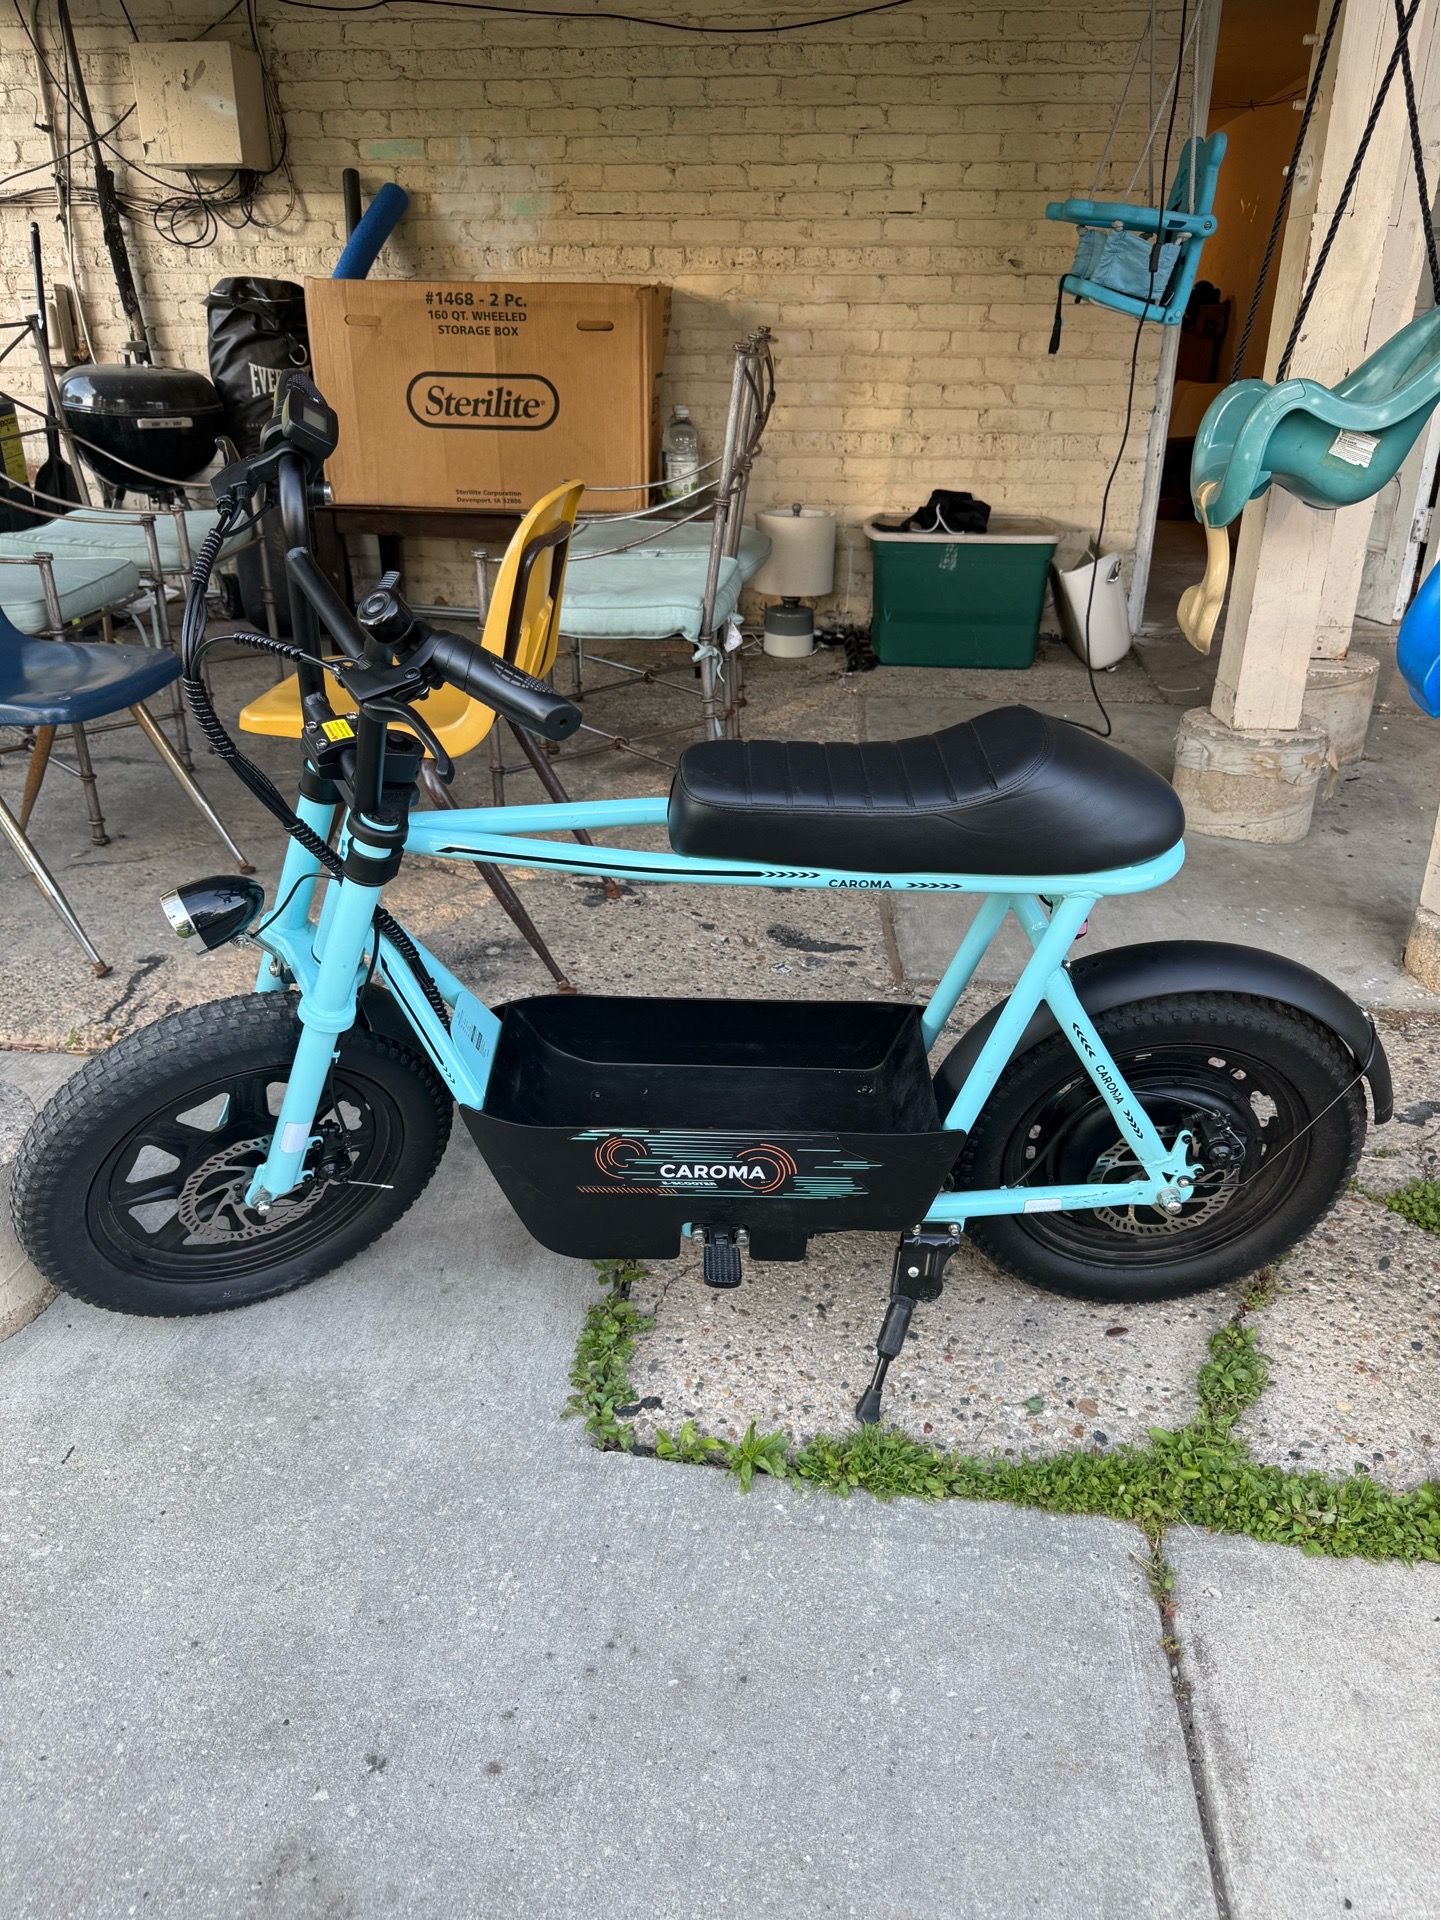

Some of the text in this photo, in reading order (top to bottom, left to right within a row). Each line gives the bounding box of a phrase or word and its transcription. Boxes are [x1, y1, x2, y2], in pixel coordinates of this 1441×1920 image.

[425, 291, 474, 306] #1468
[489, 293, 499, 307] 2
[504, 293, 528, 308] Pc.
[428, 310, 527, 322] 160 QT. WHEELED
[438, 325, 519, 337] STORAGE BOX
[425, 385, 541, 418] Sterilite
[828, 879, 892, 889] CAROMA
[1095, 1064, 1124, 1105] CAROMA
[660, 1164, 766, 1179] CAROMA
